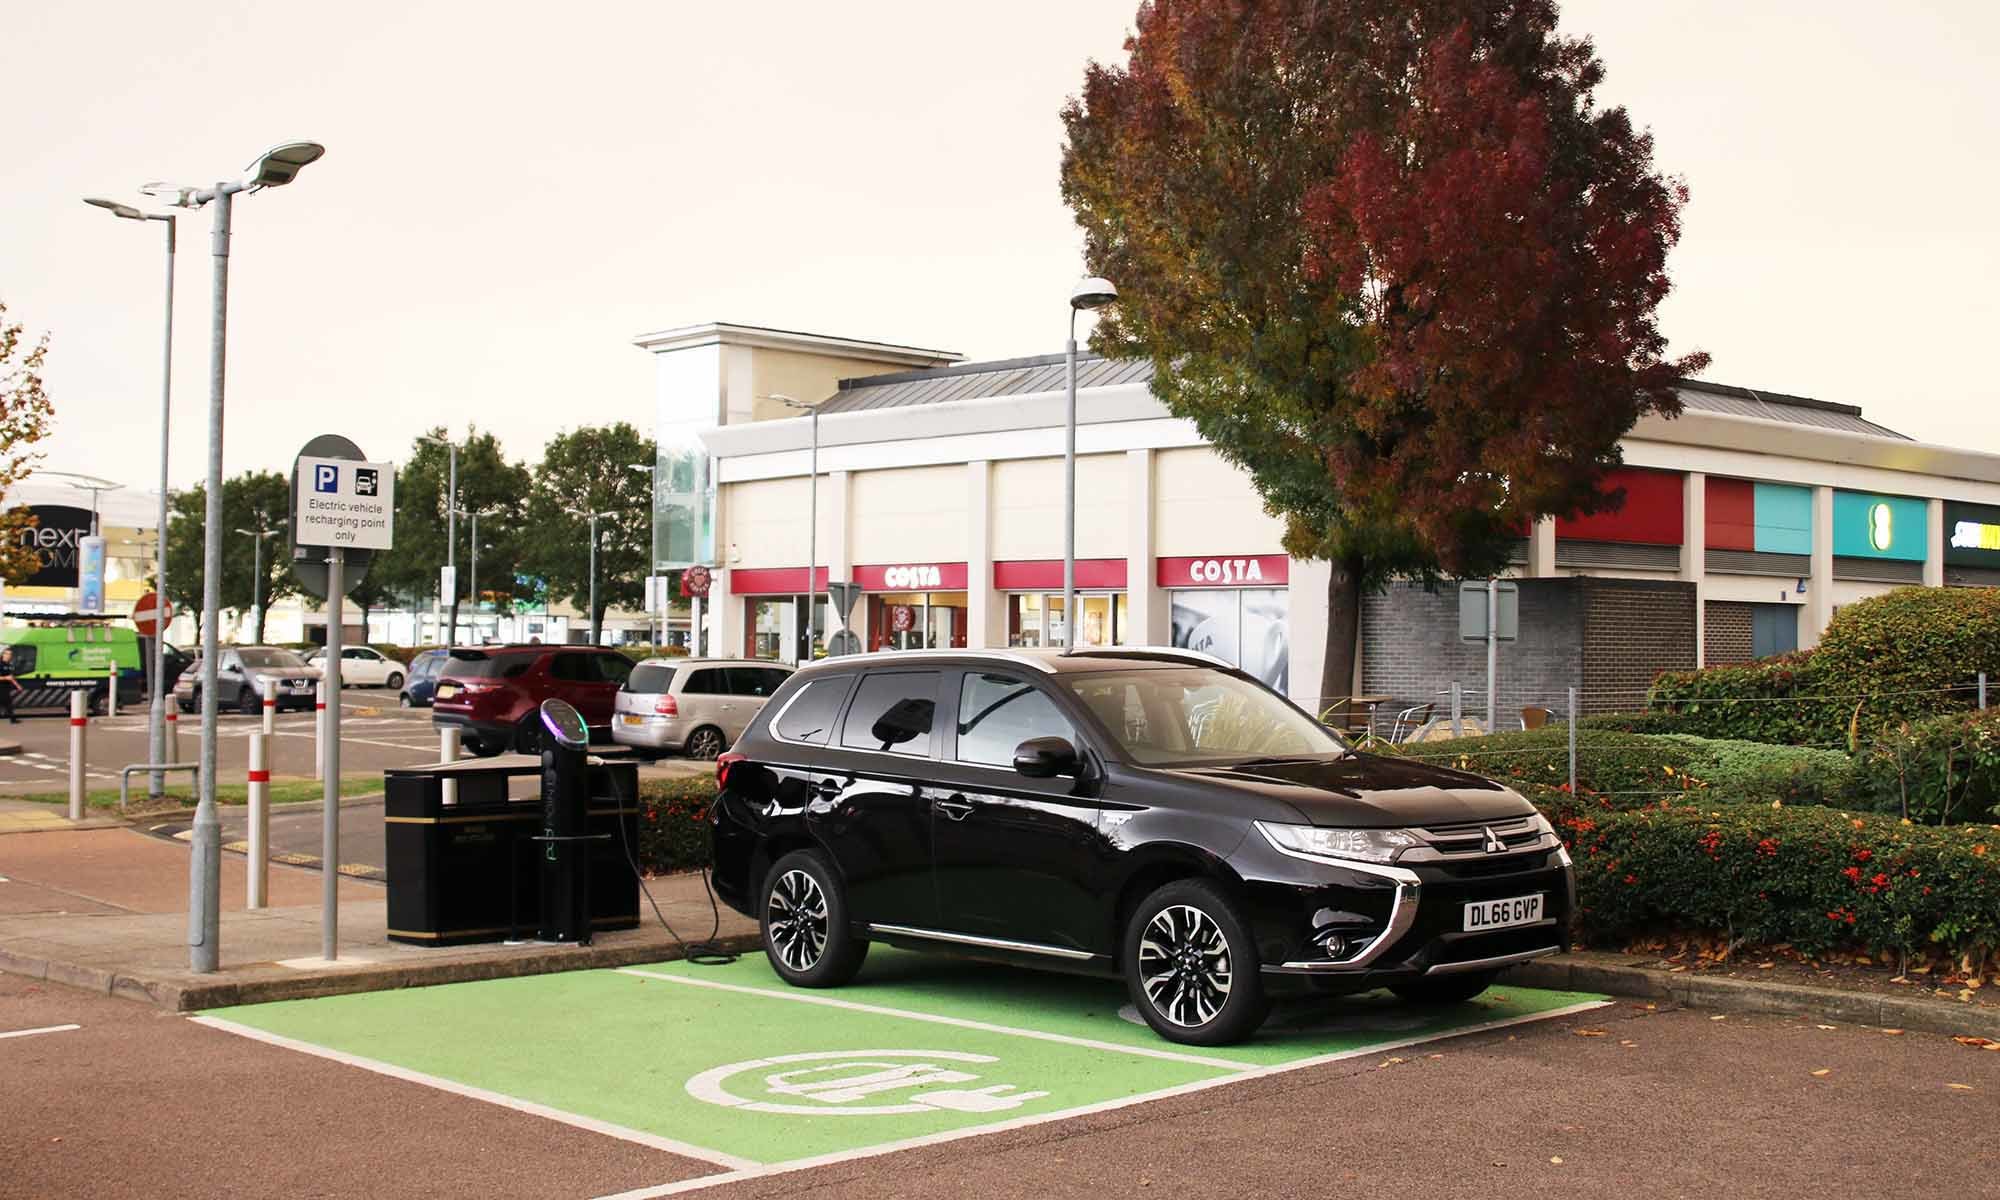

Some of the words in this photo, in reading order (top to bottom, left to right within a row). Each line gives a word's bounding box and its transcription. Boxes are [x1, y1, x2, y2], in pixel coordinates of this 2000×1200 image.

[318, 467, 335, 490] P
[309, 499, 347, 511] Electric
[349, 503, 383, 514] vehicle
[305, 515, 358, 528] recharging
[361, 519, 385, 528] point
[20, 527, 88, 548] next
[335, 531, 356, 542] only
[885, 566, 941, 589] COSTA
[1190, 559, 1262, 584] COSTA
[1471, 902, 1510, 926] DL66
[1514, 898, 1538, 920] GVP
